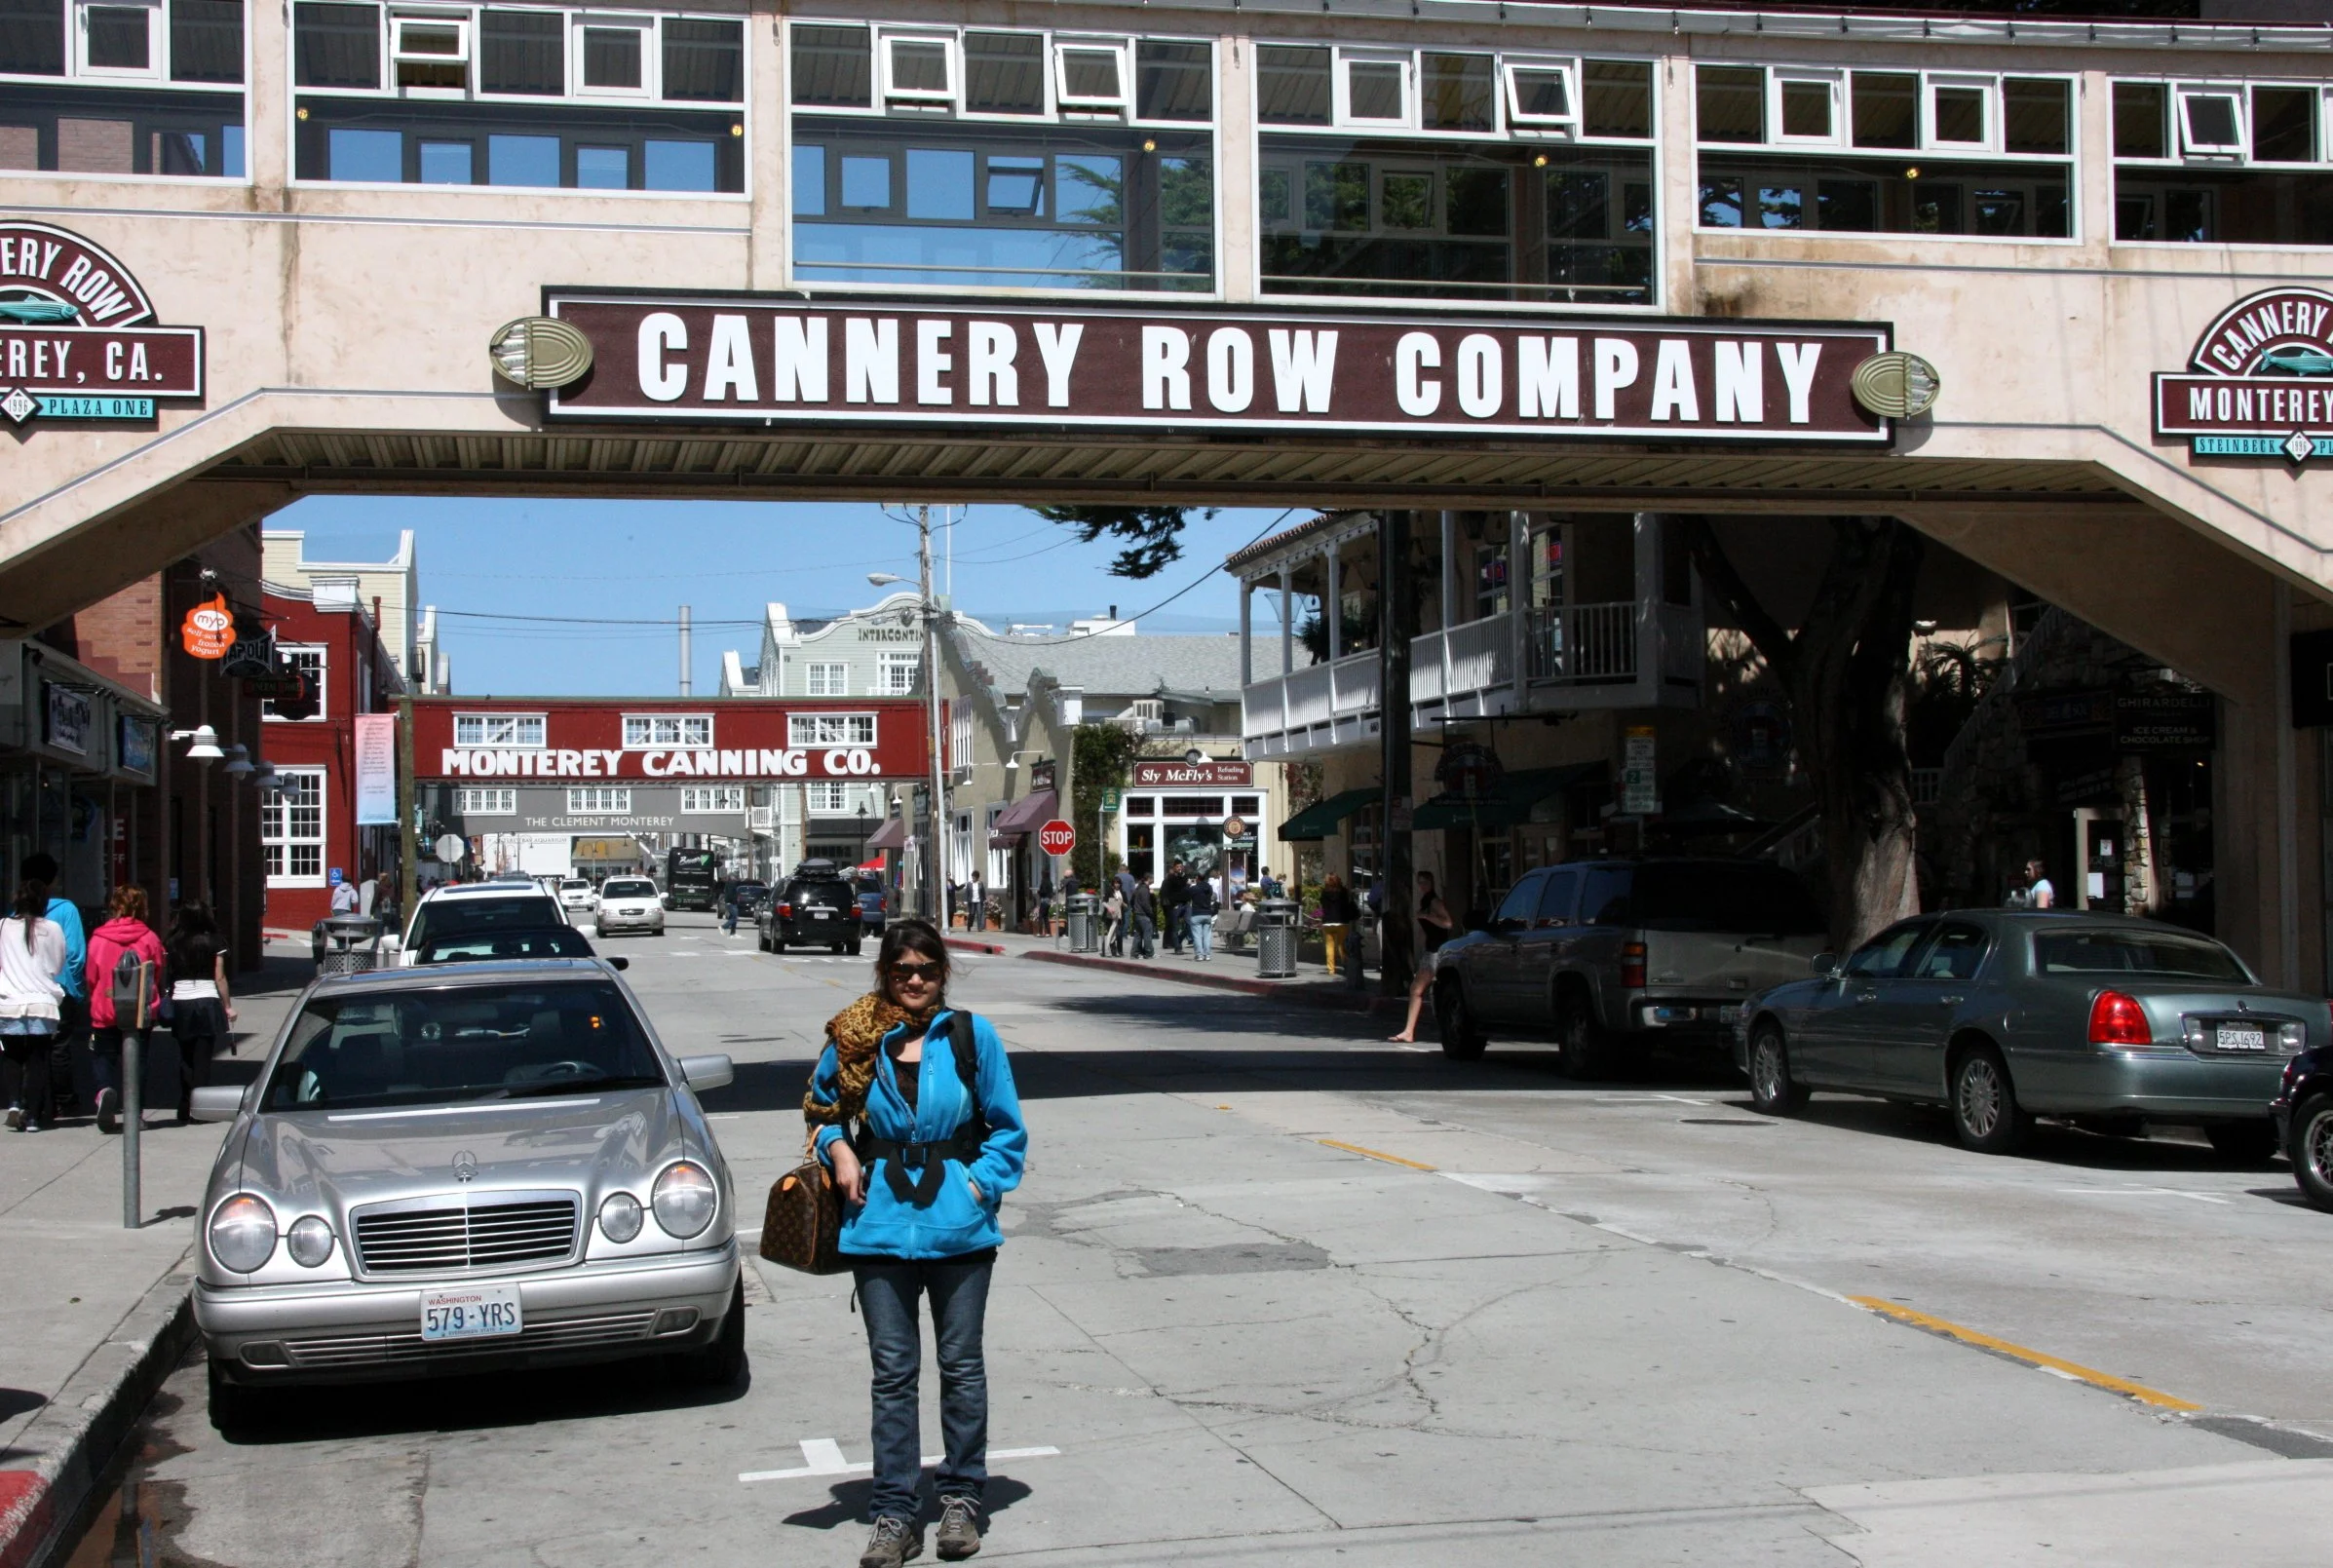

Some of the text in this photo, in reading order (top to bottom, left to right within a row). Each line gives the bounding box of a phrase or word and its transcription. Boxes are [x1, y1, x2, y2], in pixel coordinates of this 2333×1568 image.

[59, 254, 133, 322] ROW
[2212, 301, 2329, 370] CANNERY
[0, 339, 163, 383] REY, CA.
[638, 312, 1822, 425] CANNERY ROW COMPANY
[8, 399, 28, 413] 1996
[50, 399, 148, 415] PLAZA ONE
[2199, 439, 2276, 452] STEINBECK
[197, 615, 225, 628] myo
[191, 644, 219, 655] yogurt
[2117, 697, 2211, 708] GHIRARDELLI
[2132, 726, 2150, 735] ICE
[2151, 726, 2188, 735] CREAM
[2120, 735, 2181, 745] CHOCOLATE
[441, 748, 881, 777] MONTEREY CANNING CO.
[1141, 769, 1213, 784] Sly McFly's
[524, 817, 674, 826] THE CLEMENT MONTEREY
[1042, 830, 1072, 845] STOP
[428, 1294, 482, 1305] WASHINGTON
